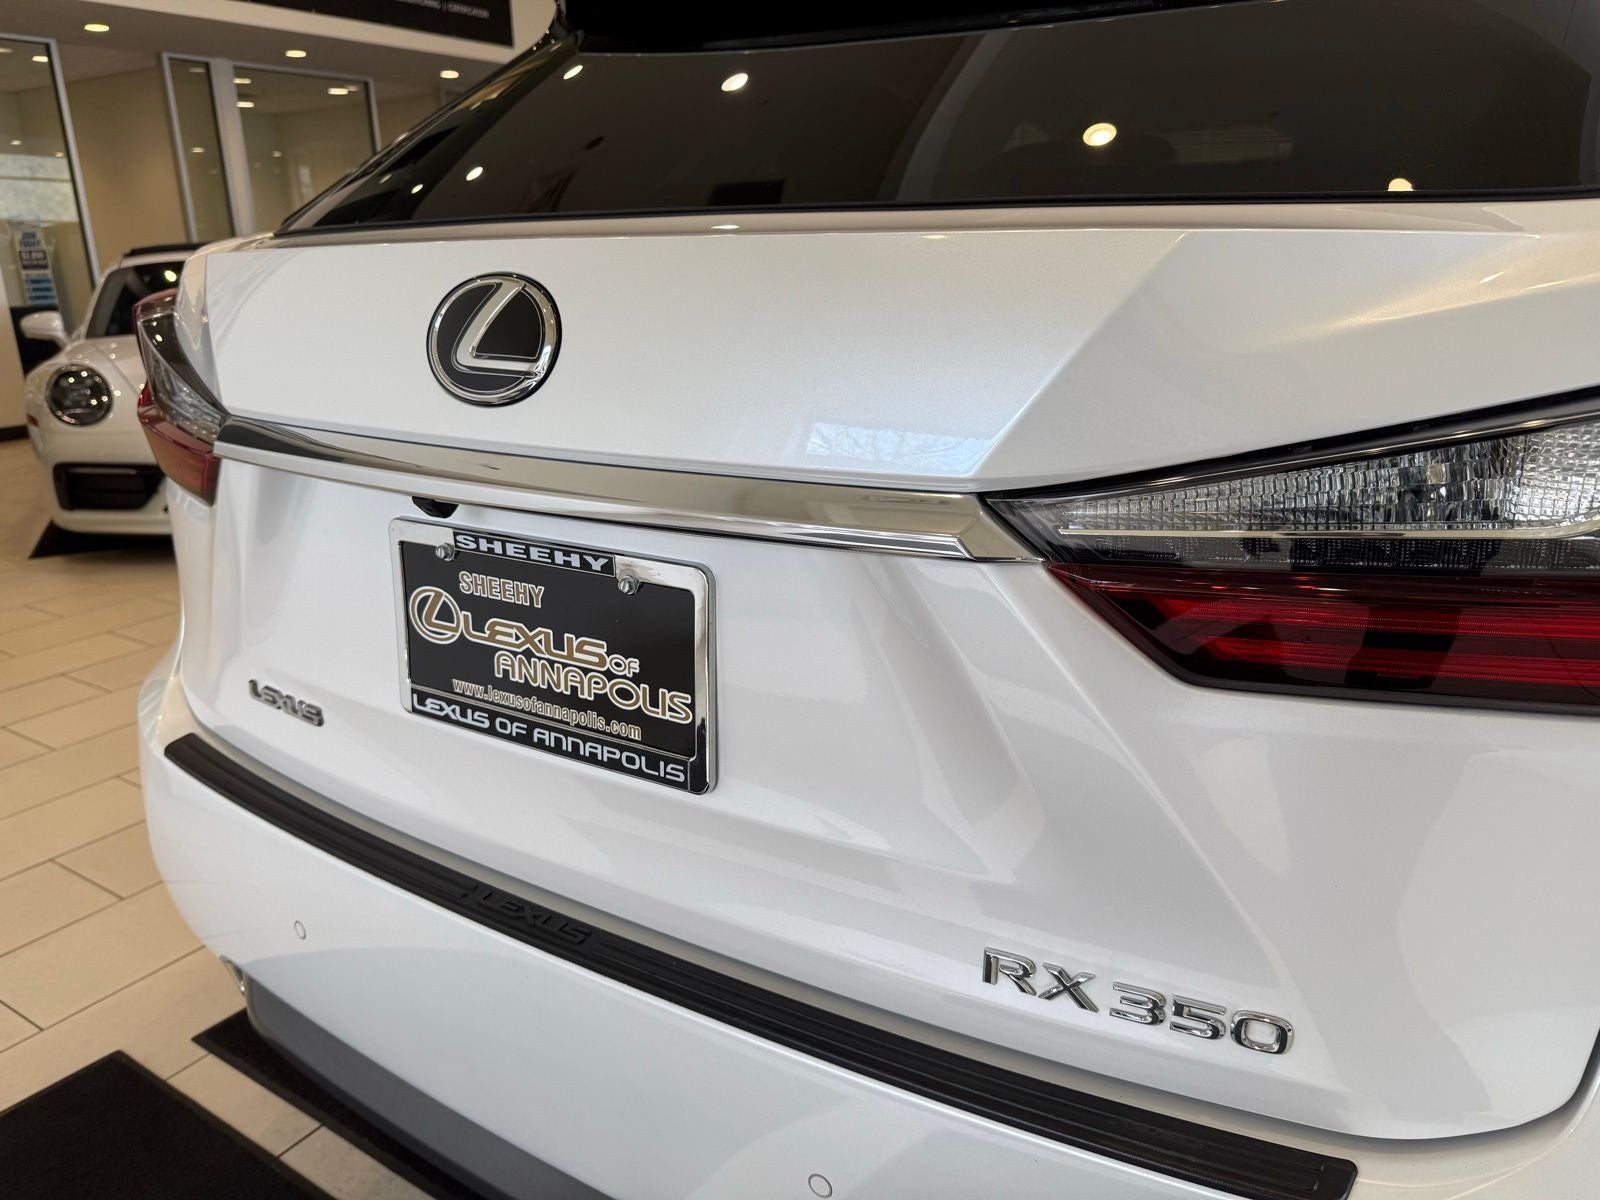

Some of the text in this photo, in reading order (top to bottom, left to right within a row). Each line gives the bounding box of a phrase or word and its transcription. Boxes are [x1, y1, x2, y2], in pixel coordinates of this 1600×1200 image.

[455, 534, 609, 571] SHEEHY
[459, 571, 545, 608] SHEEHY
[461, 611, 608, 672] LEXUS
[608, 654, 640, 677] OF
[248, 679, 324, 727] LEXUS
[452, 678, 642, 740] www.lexusofannapolis.com
[494, 650, 693, 724] ANNAPOLIS
[412, 693, 685, 783] LEXUS OF ANNAPOLIS
[479, 891, 593, 945] LEXUS
[981, 946, 1294, 1055] RX 350
